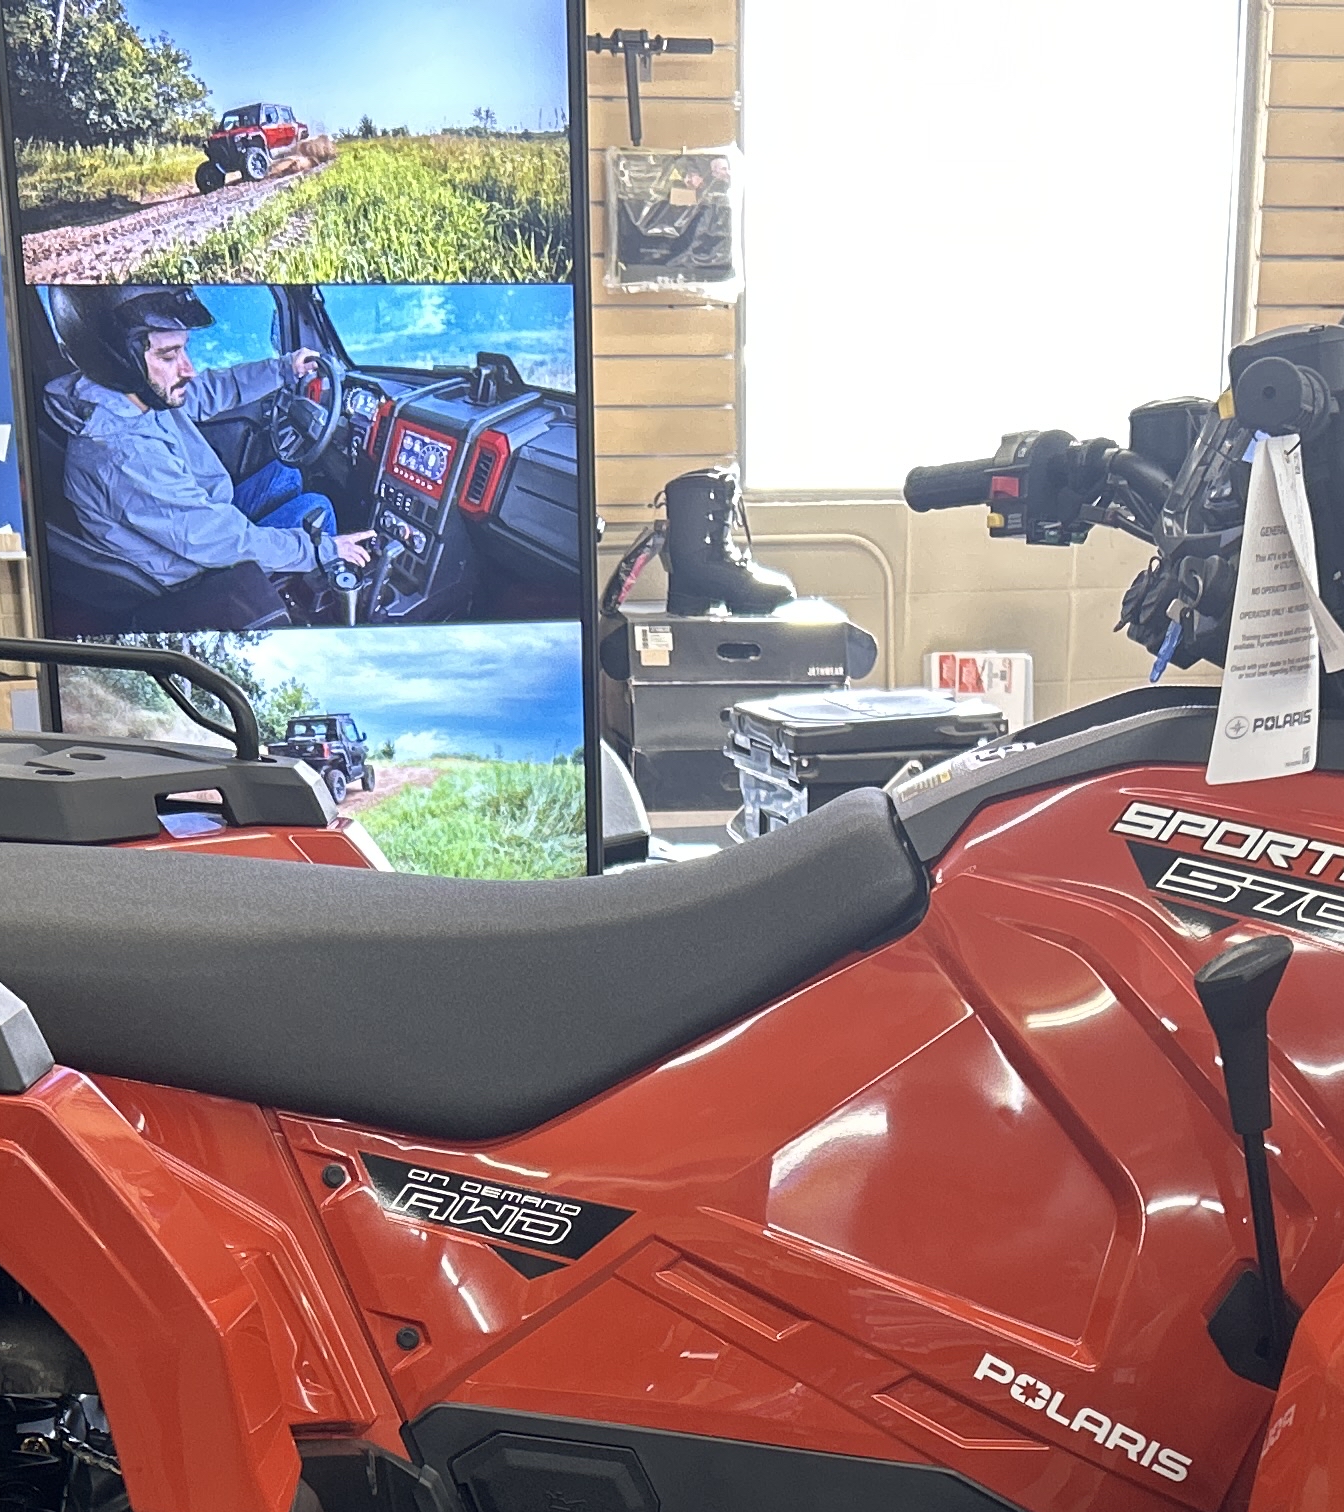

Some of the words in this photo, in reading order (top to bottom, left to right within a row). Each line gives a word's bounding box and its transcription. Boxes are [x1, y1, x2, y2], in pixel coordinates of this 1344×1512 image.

[1252, 708, 1313, 734] POLARIS
[390, 1183, 573, 1245] AWD
[460, 1181, 582, 1216] DEMAND
[973, 1352, 1193, 1482] POLARIS
